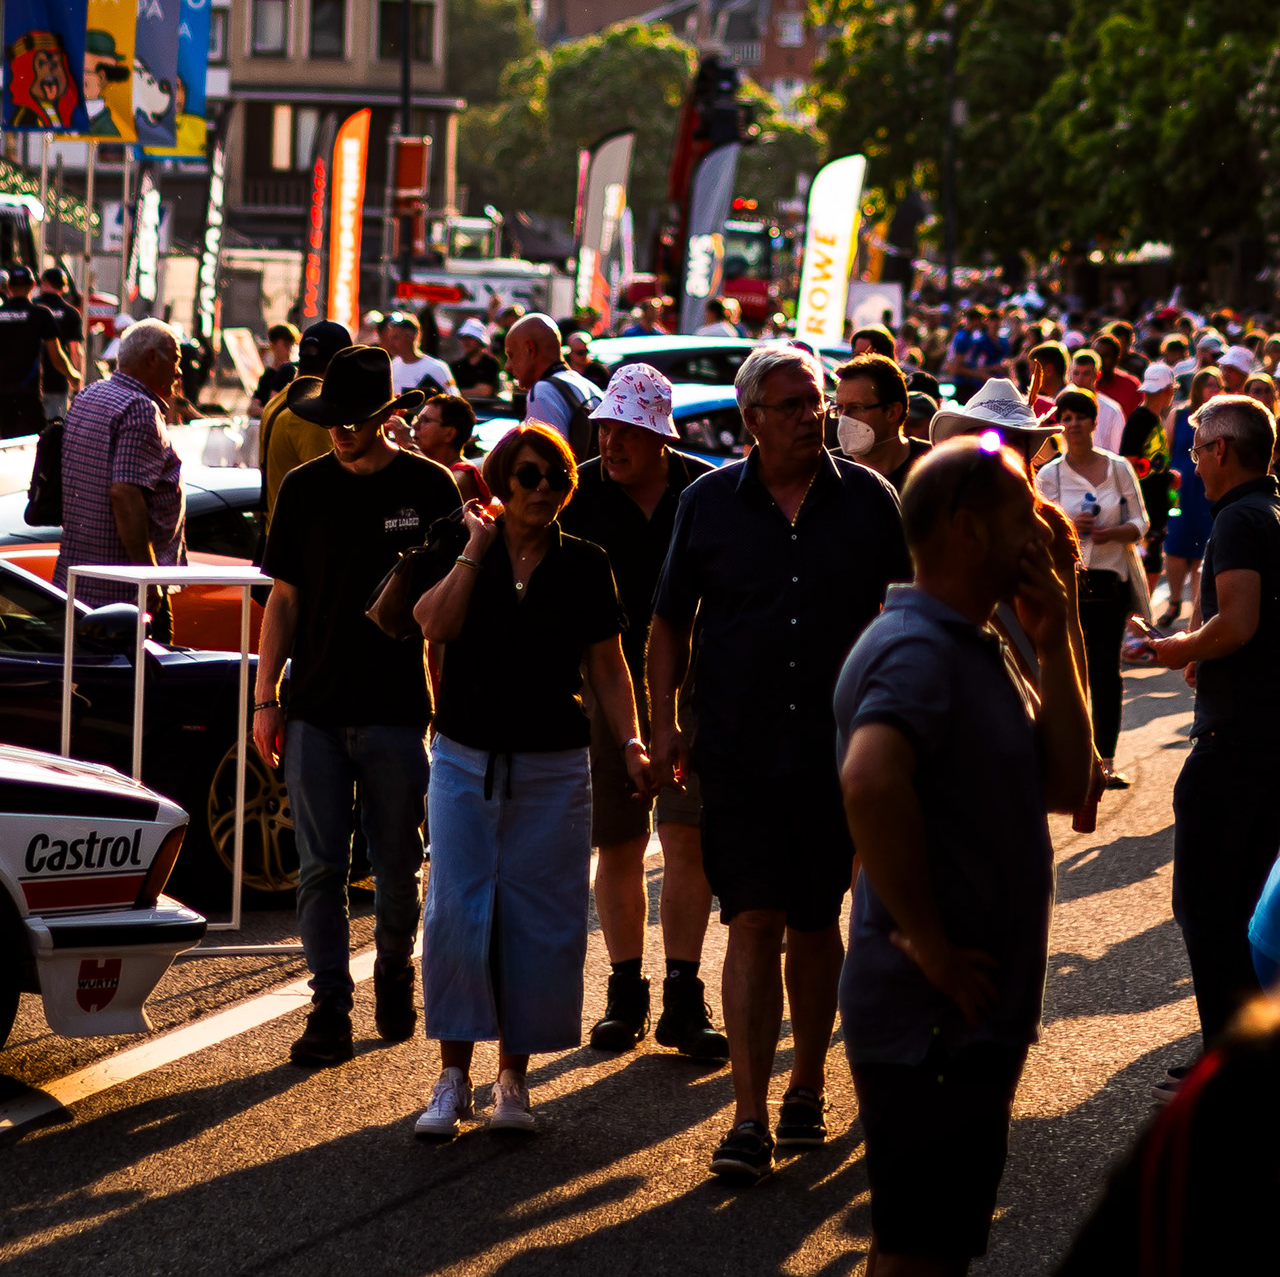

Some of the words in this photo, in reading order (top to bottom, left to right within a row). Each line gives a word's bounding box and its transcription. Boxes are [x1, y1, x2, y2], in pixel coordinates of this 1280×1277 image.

[805, 230, 837, 335] ROWE
[384, 519, 398, 529] STAY
[398, 517, 420, 528] LOADED
[25, 828, 143, 873] Castrol
